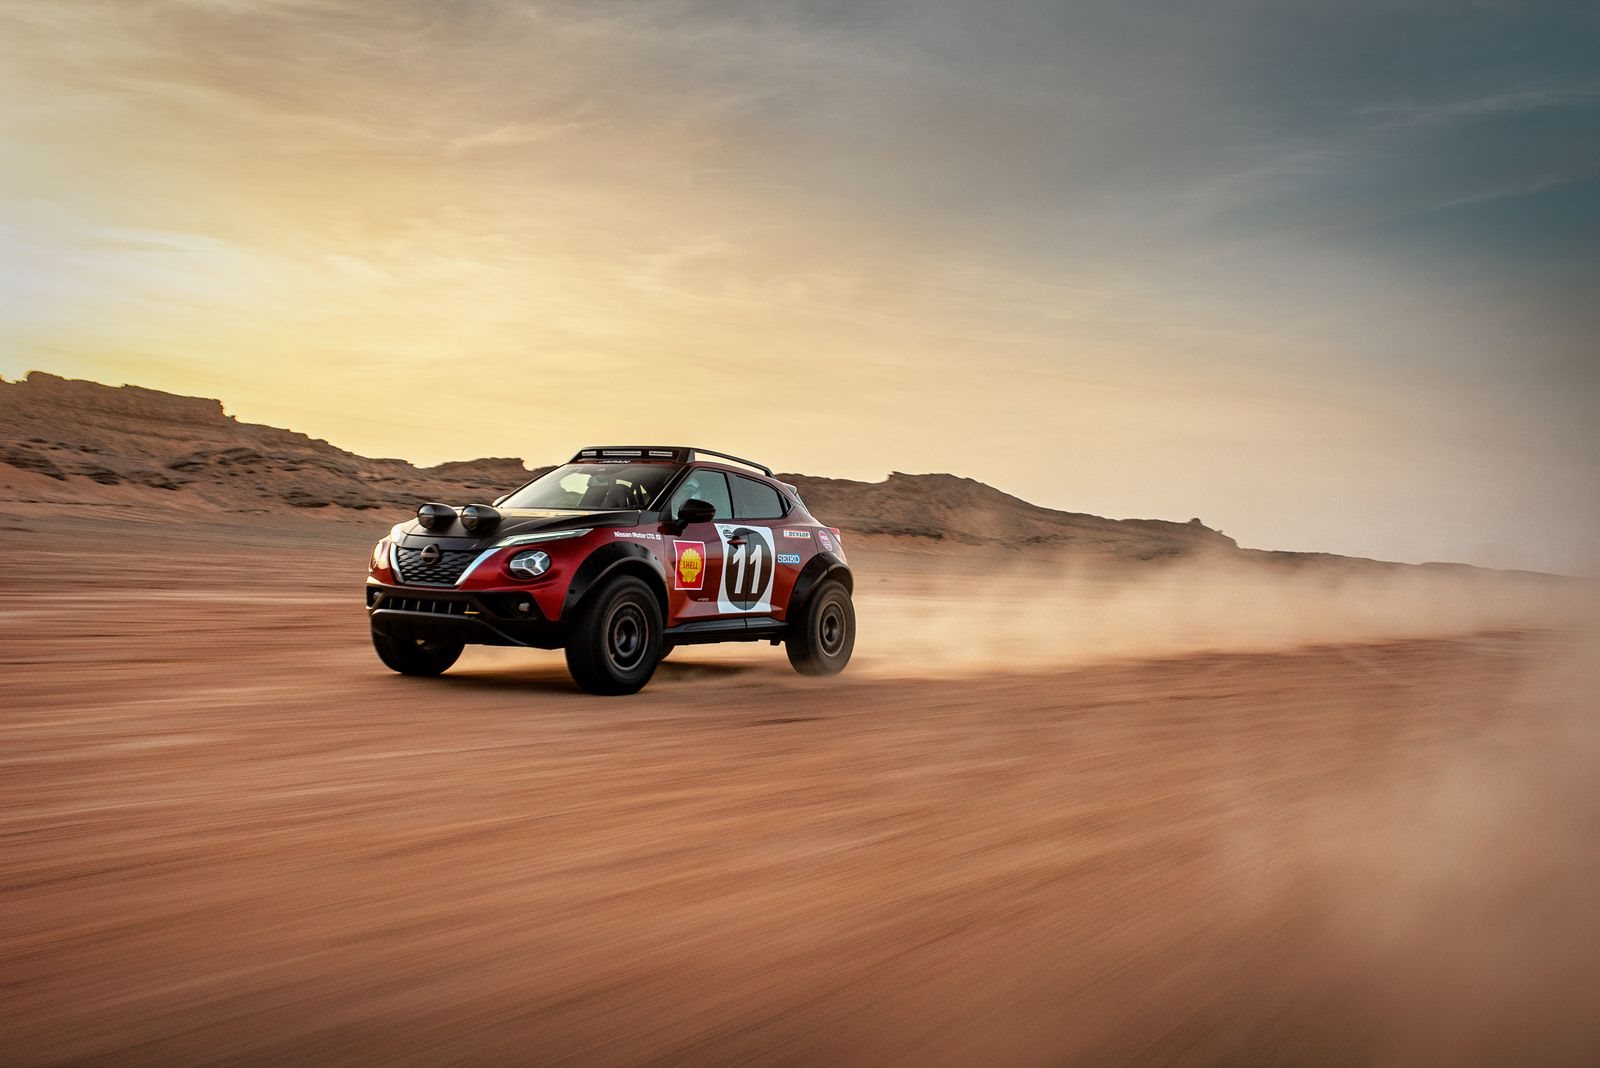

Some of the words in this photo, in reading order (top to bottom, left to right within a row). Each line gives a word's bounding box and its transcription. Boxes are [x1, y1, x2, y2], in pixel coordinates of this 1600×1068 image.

[777, 554, 800, 564] SEIKO
[682, 561, 698, 570] SHELL
[732, 544, 762, 594] 11
